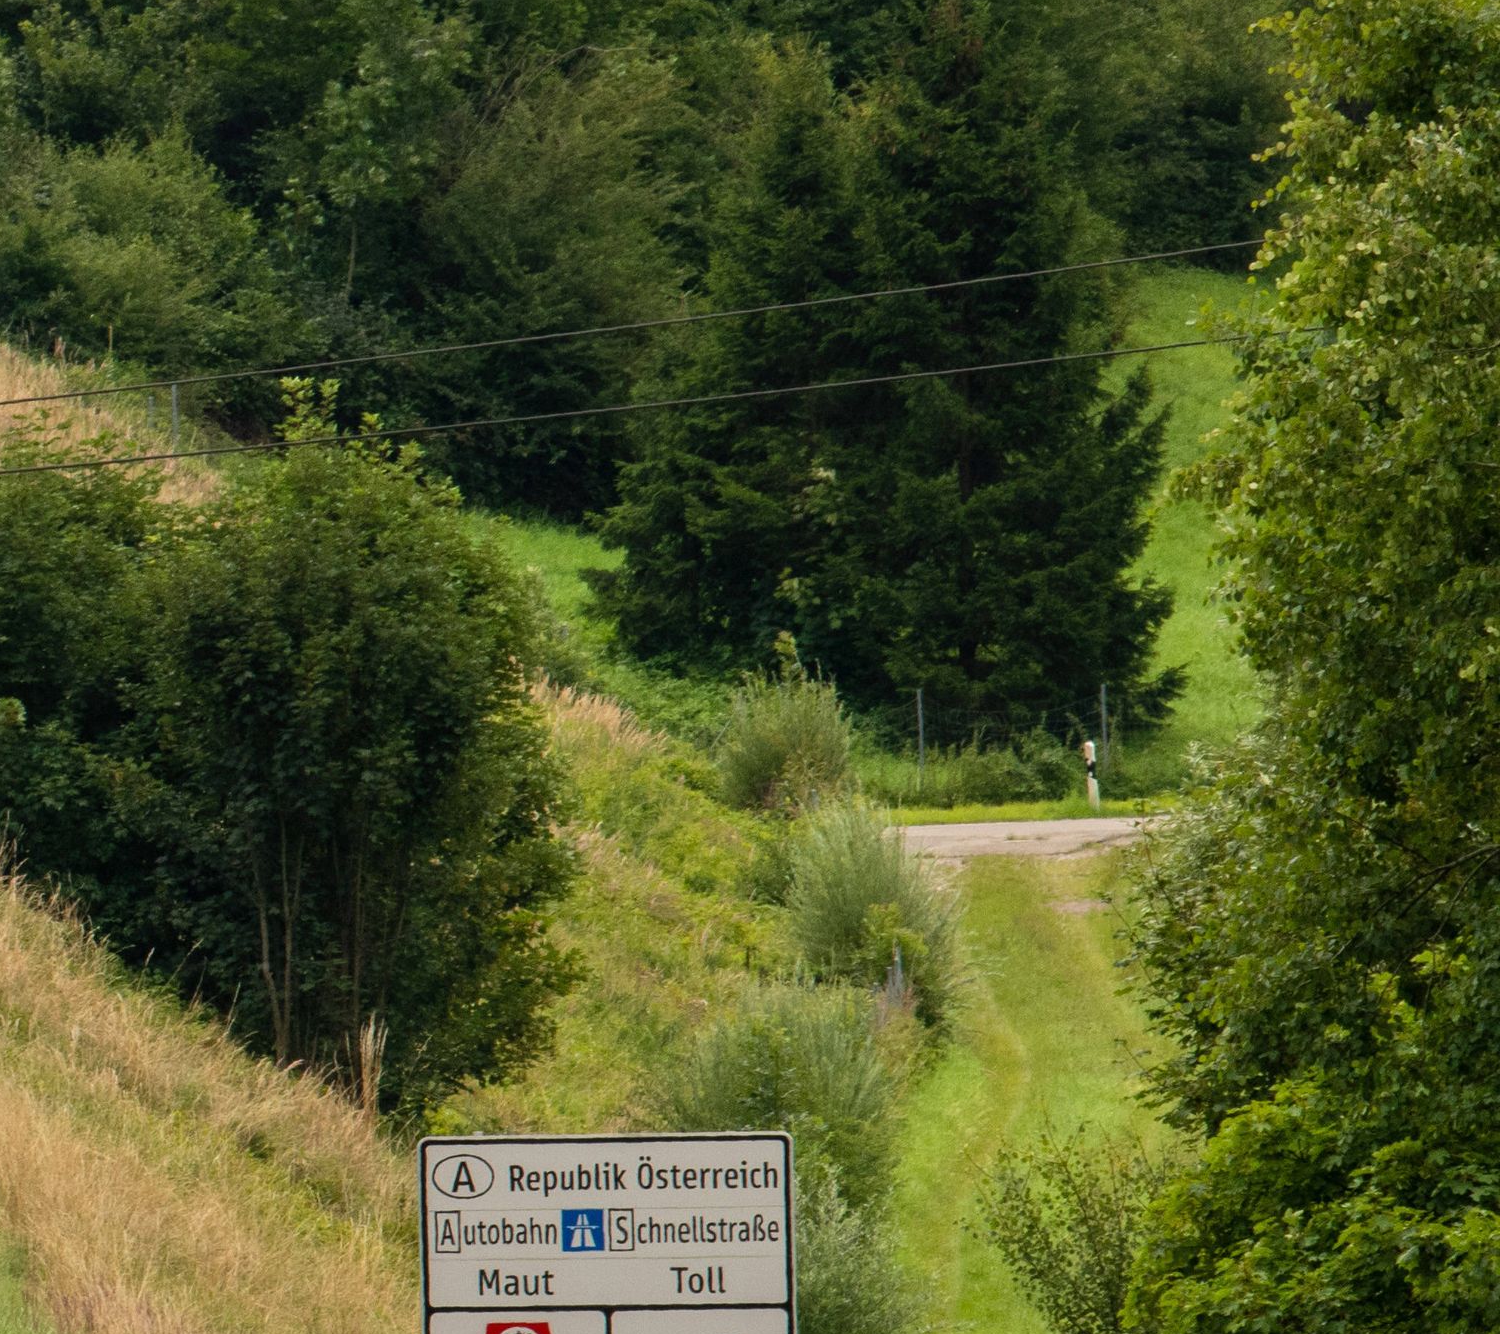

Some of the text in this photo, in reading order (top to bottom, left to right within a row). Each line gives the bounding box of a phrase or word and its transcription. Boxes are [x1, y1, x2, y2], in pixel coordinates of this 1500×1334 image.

[451, 1155, 779, 1198] A Republik Österreich
[440, 1213, 780, 1247] Autobahn Schnellstraße
[478, 1269, 555, 1296] Maut
[669, 1266, 727, 1294] Toll
